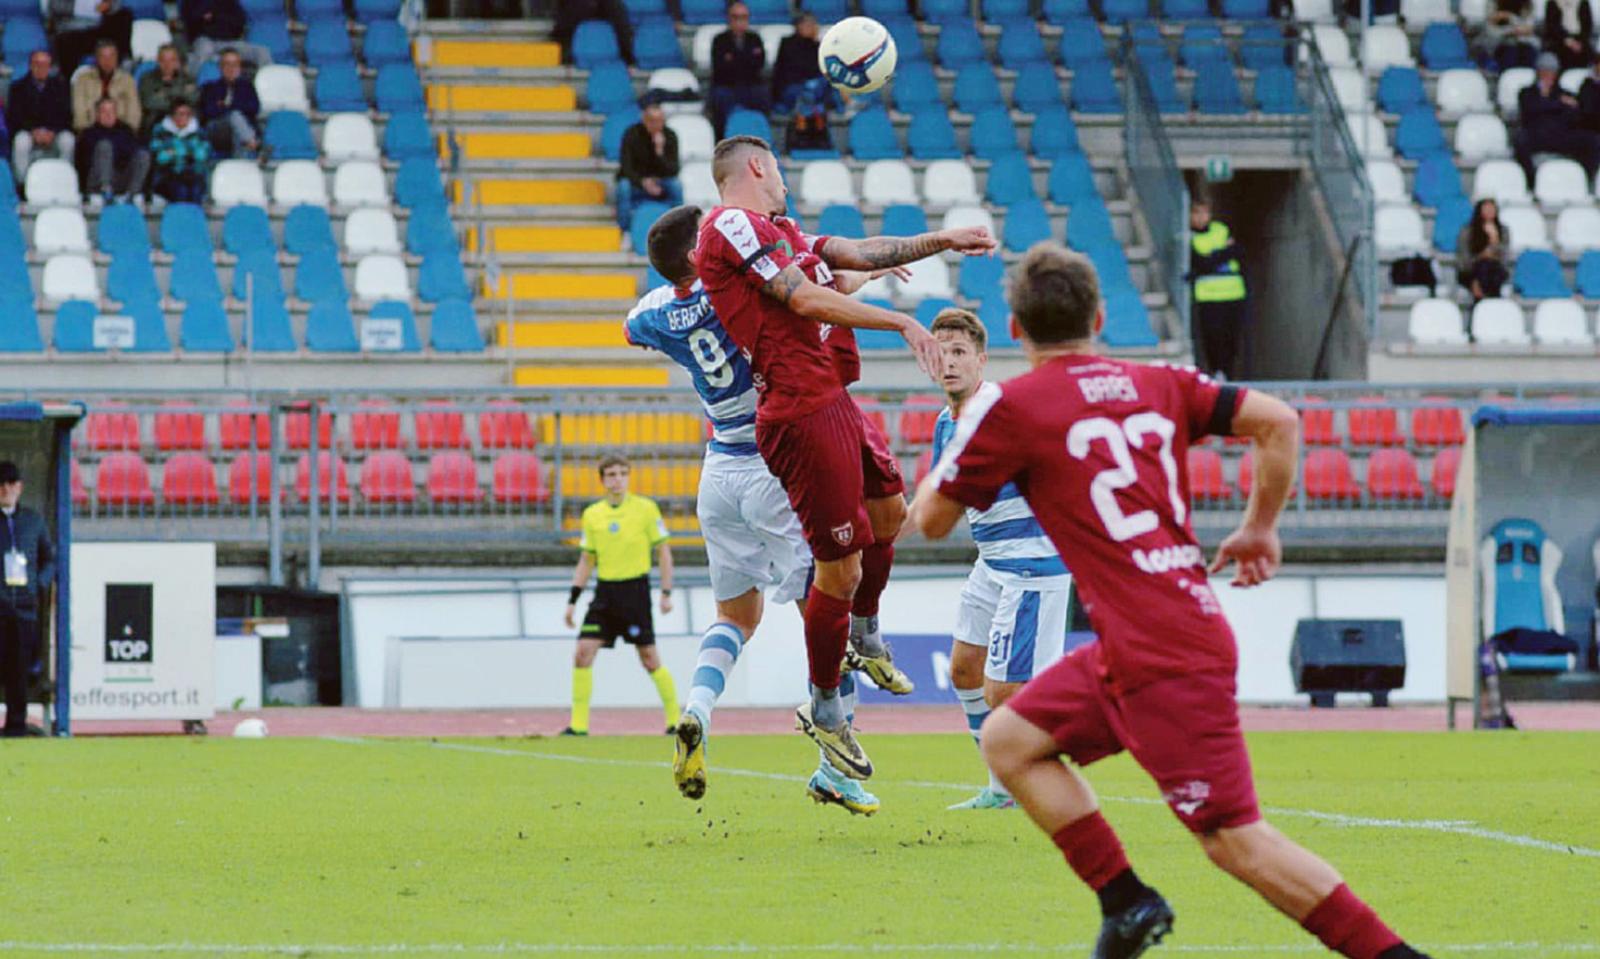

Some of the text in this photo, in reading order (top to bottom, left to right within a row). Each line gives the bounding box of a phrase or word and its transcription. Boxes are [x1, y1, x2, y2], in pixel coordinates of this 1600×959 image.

[1066, 411, 1186, 542] 27
[109, 640, 149, 660] TOP
[990, 631, 1011, 661] 31
[73, 686, 199, 709] effesport.it
